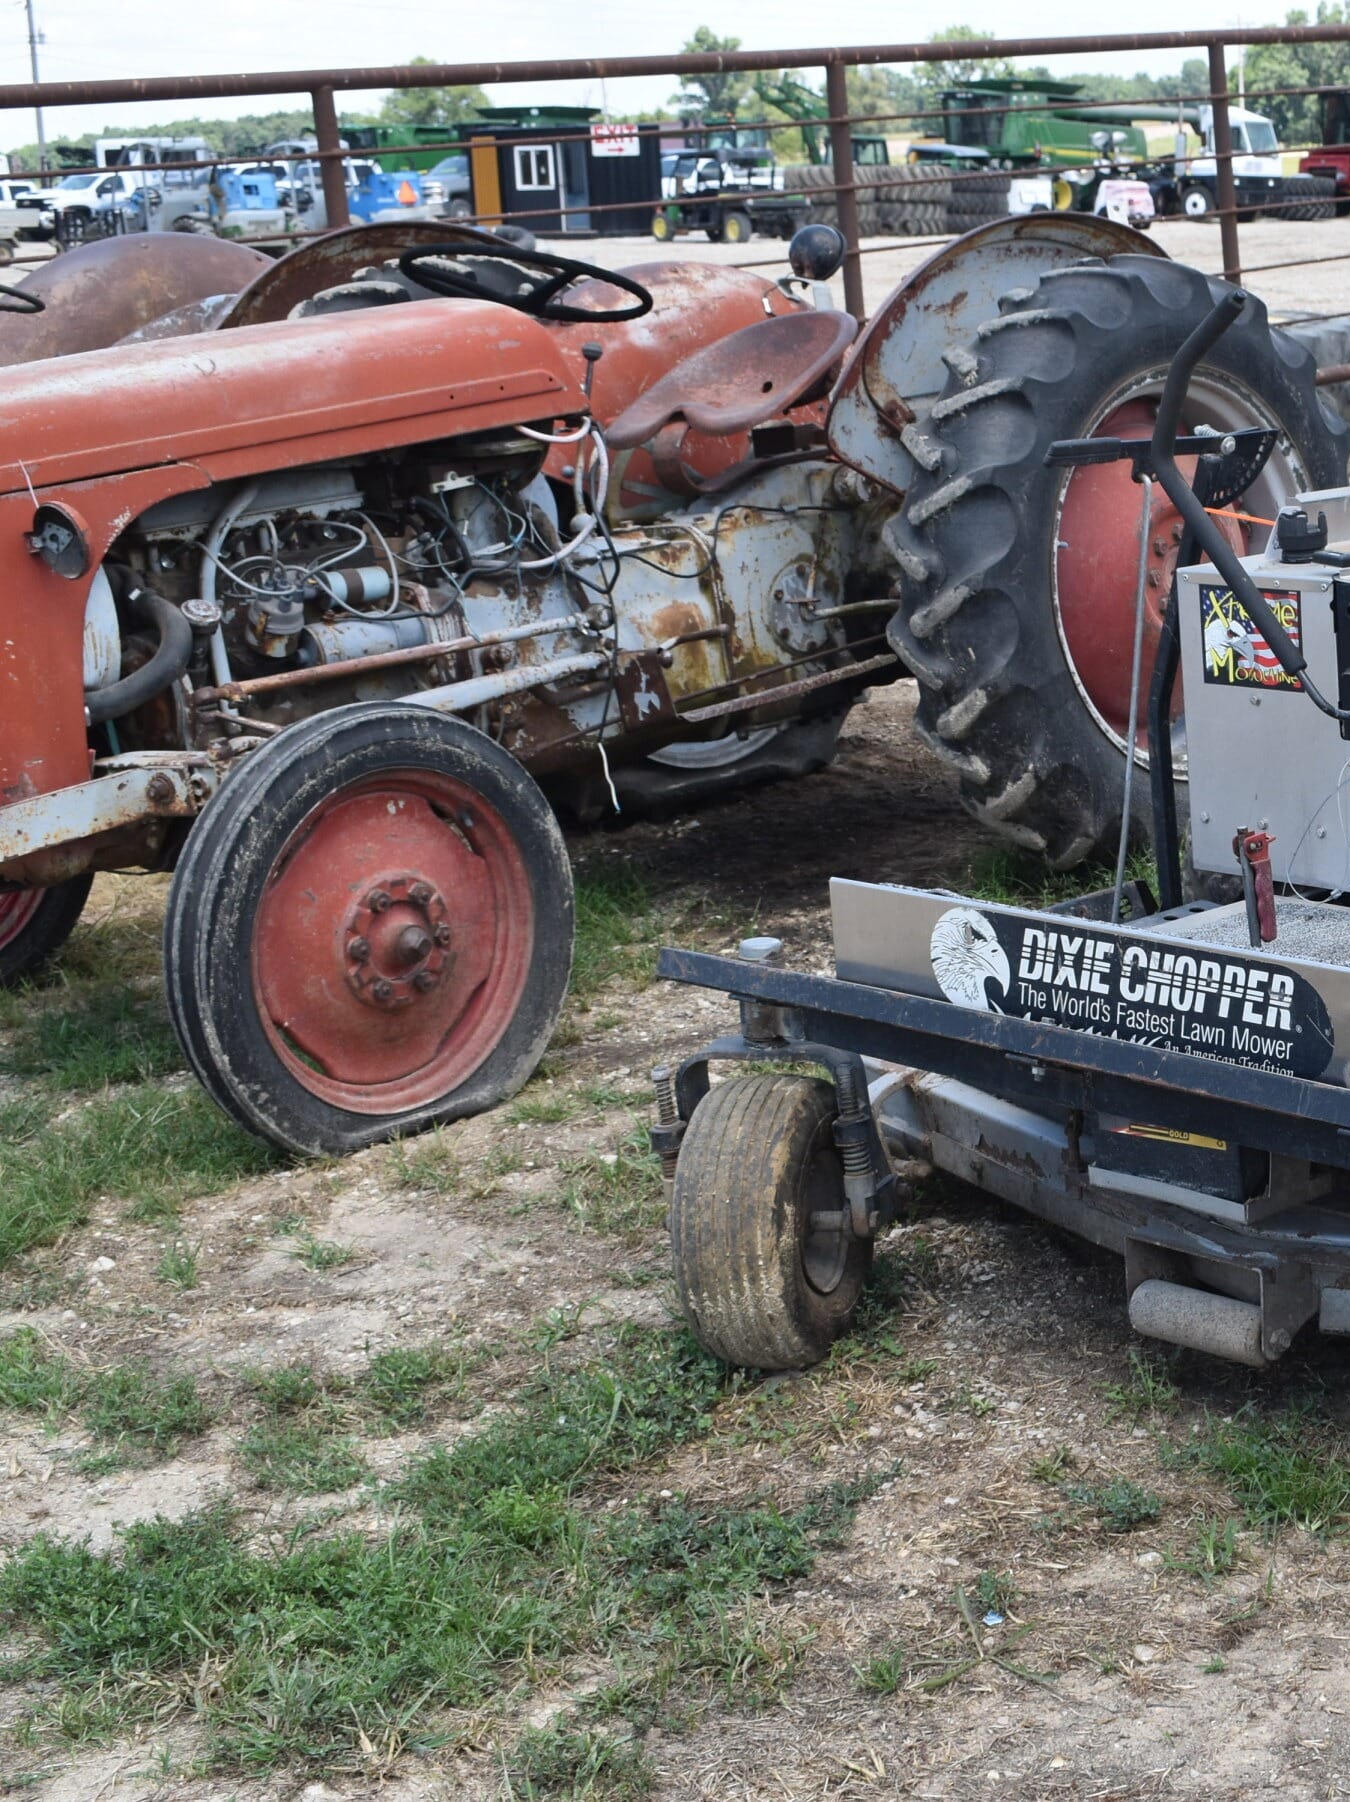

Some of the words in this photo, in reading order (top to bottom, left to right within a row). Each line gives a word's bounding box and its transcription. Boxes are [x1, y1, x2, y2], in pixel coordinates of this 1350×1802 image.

[594, 124, 635, 143] EXIT
[1018, 927, 1115, 995] DIXIE
[1119, 946, 1295, 1031] CHOPPER
[1018, 981, 1046, 1009] The
[1051, 989, 1111, 1023] World's
[1116, 1002, 1175, 1037] Fastest
[1181, 1018, 1226, 1047] Lawn
[1232, 1025, 1294, 1060] Mower
[1164, 1040, 1180, 1053] An
[1184, 1045, 1236, 1065] American
[1238, 1056, 1294, 1077] Tradition
[1168, 1129, 1189, 1140] GOLD
